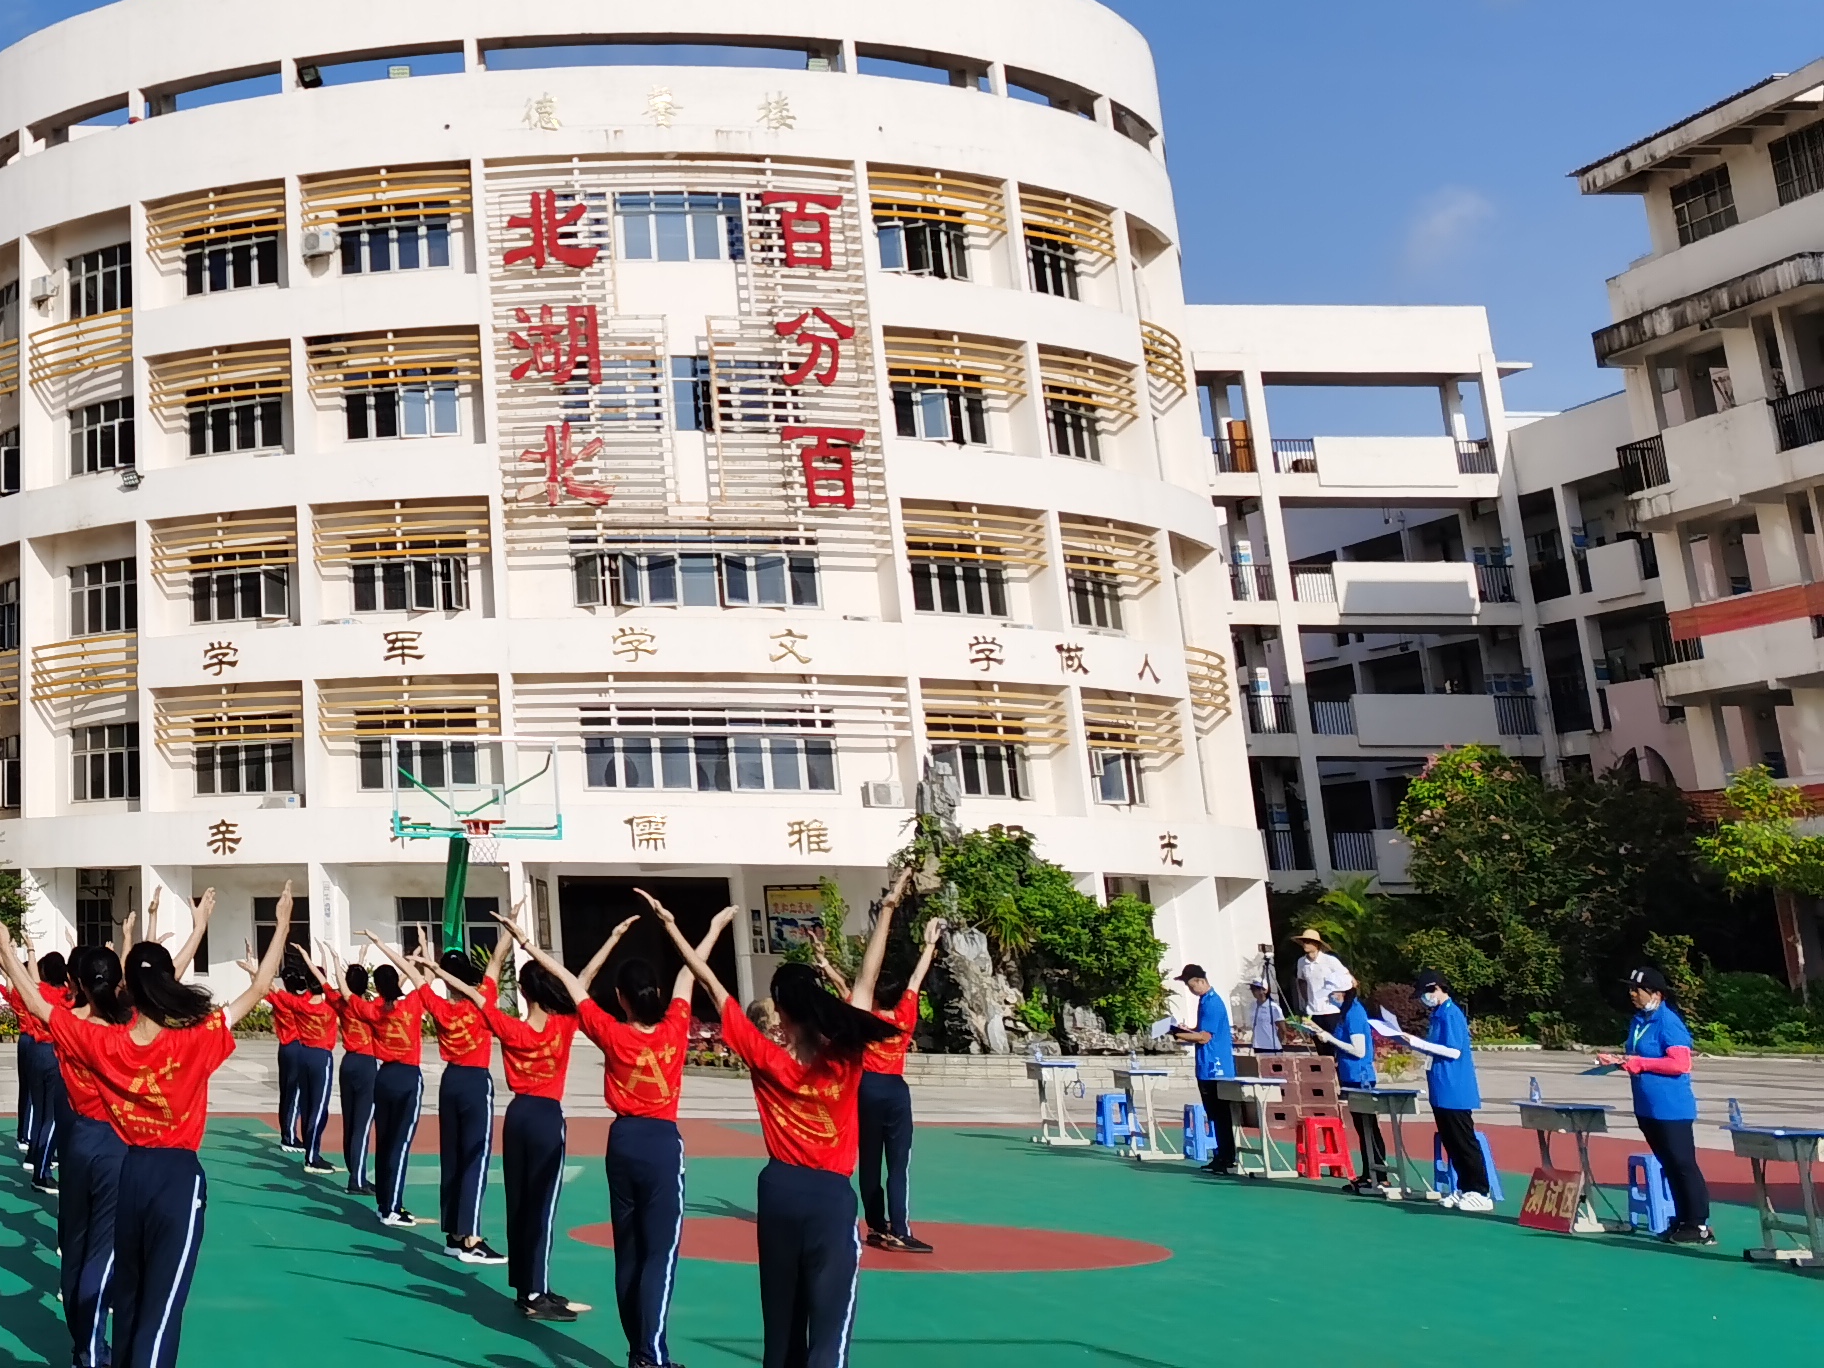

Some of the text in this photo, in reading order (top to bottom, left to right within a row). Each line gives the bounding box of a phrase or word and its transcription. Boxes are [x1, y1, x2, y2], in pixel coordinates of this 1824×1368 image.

[503, 189, 616, 506] 北湖北
[762, 191, 866, 509] 百分百
[627, 1043, 676, 1097] A+
[1524, 1178, 1578, 1219] 测试区
